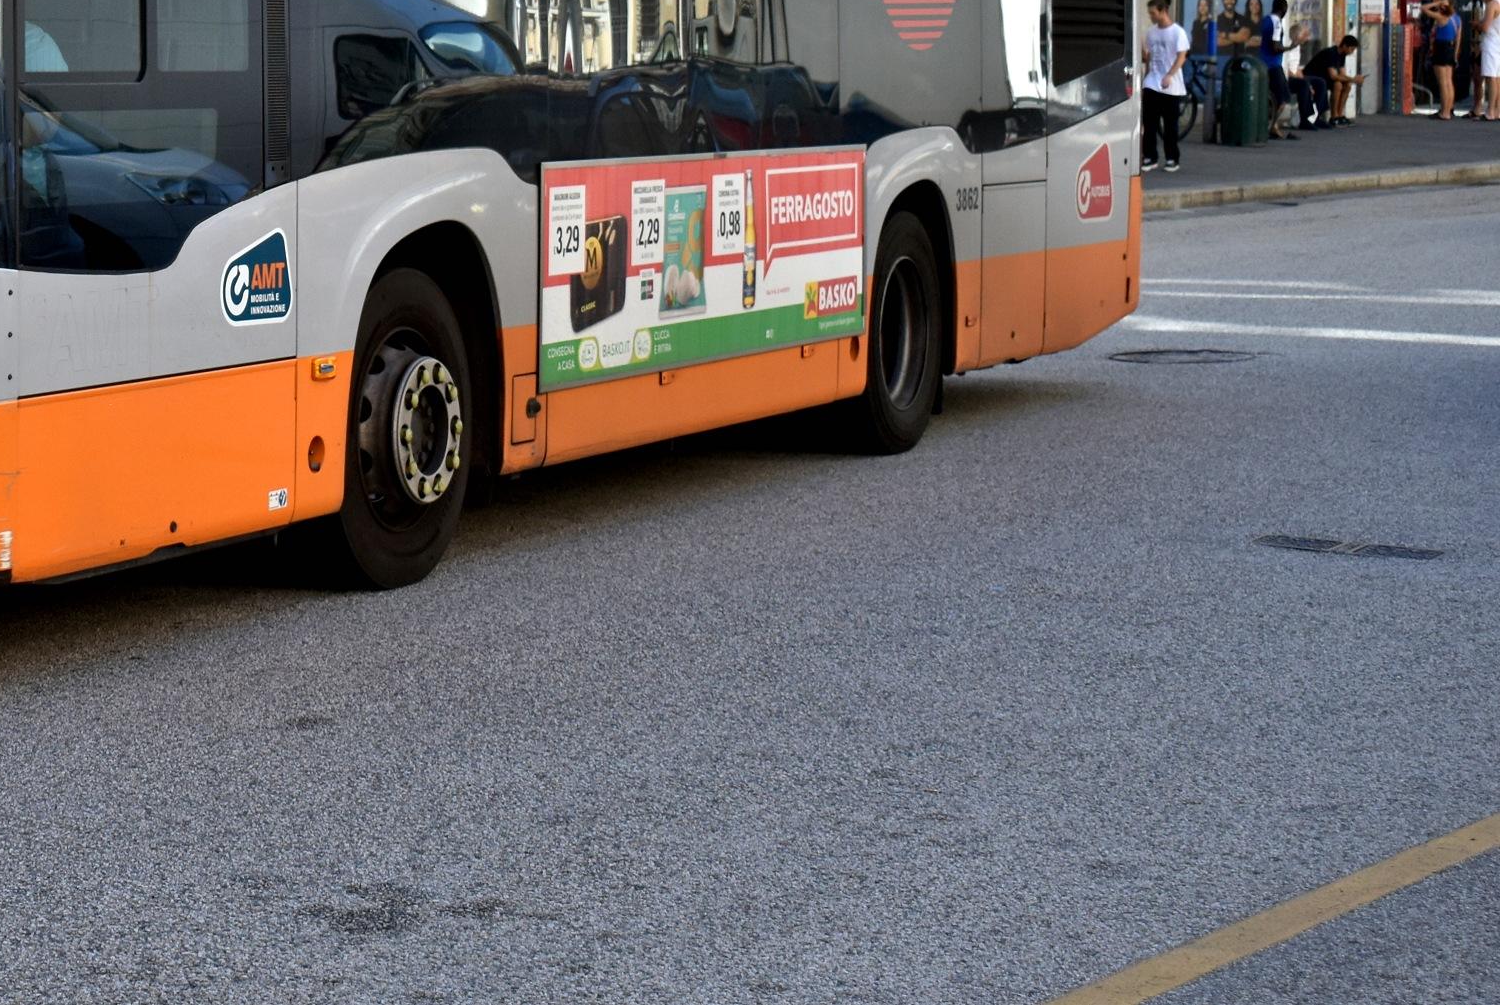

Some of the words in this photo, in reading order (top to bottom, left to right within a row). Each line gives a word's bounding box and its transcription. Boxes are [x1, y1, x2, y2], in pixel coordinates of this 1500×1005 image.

[770, 189, 854, 225] FERRAGOSTO
[956, 187, 979, 212] 3862
[251, 261, 285, 290] AMT
[275, 292, 280, 302] E
[818, 281, 856, 311] BASKO
[250, 303, 286, 315] INNOVAZIONE
[547, 345, 575, 359] CONSEGNA
[557, 362, 562, 371] A
[562, 359, 575, 371] CASA
